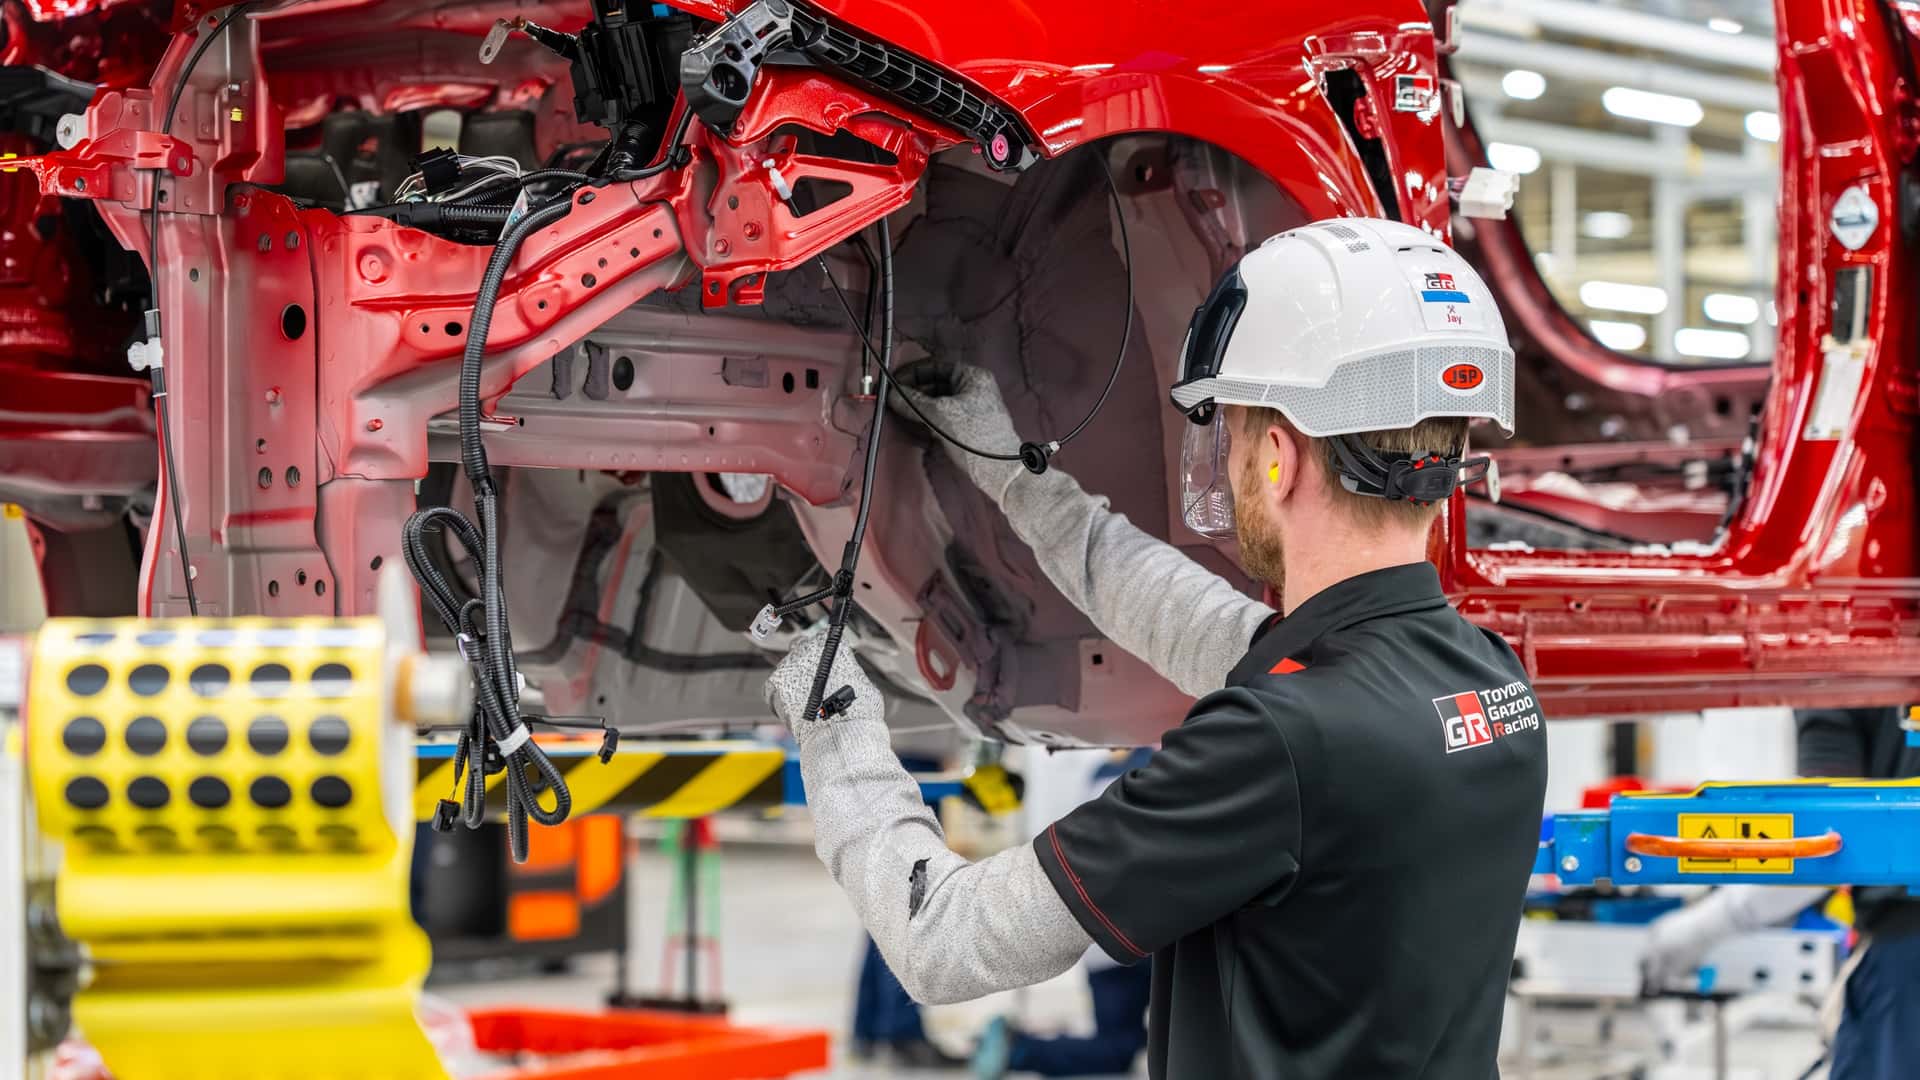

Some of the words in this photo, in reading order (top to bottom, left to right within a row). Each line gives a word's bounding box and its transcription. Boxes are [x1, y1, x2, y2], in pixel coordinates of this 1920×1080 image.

[1448, 369, 1477, 383] JSP
[1480, 681, 1528, 705] TOYOTA
[1487, 696, 1534, 721] GAZOO
[1446, 712, 1490, 747] GR
[1493, 713, 1539, 738] Racing
